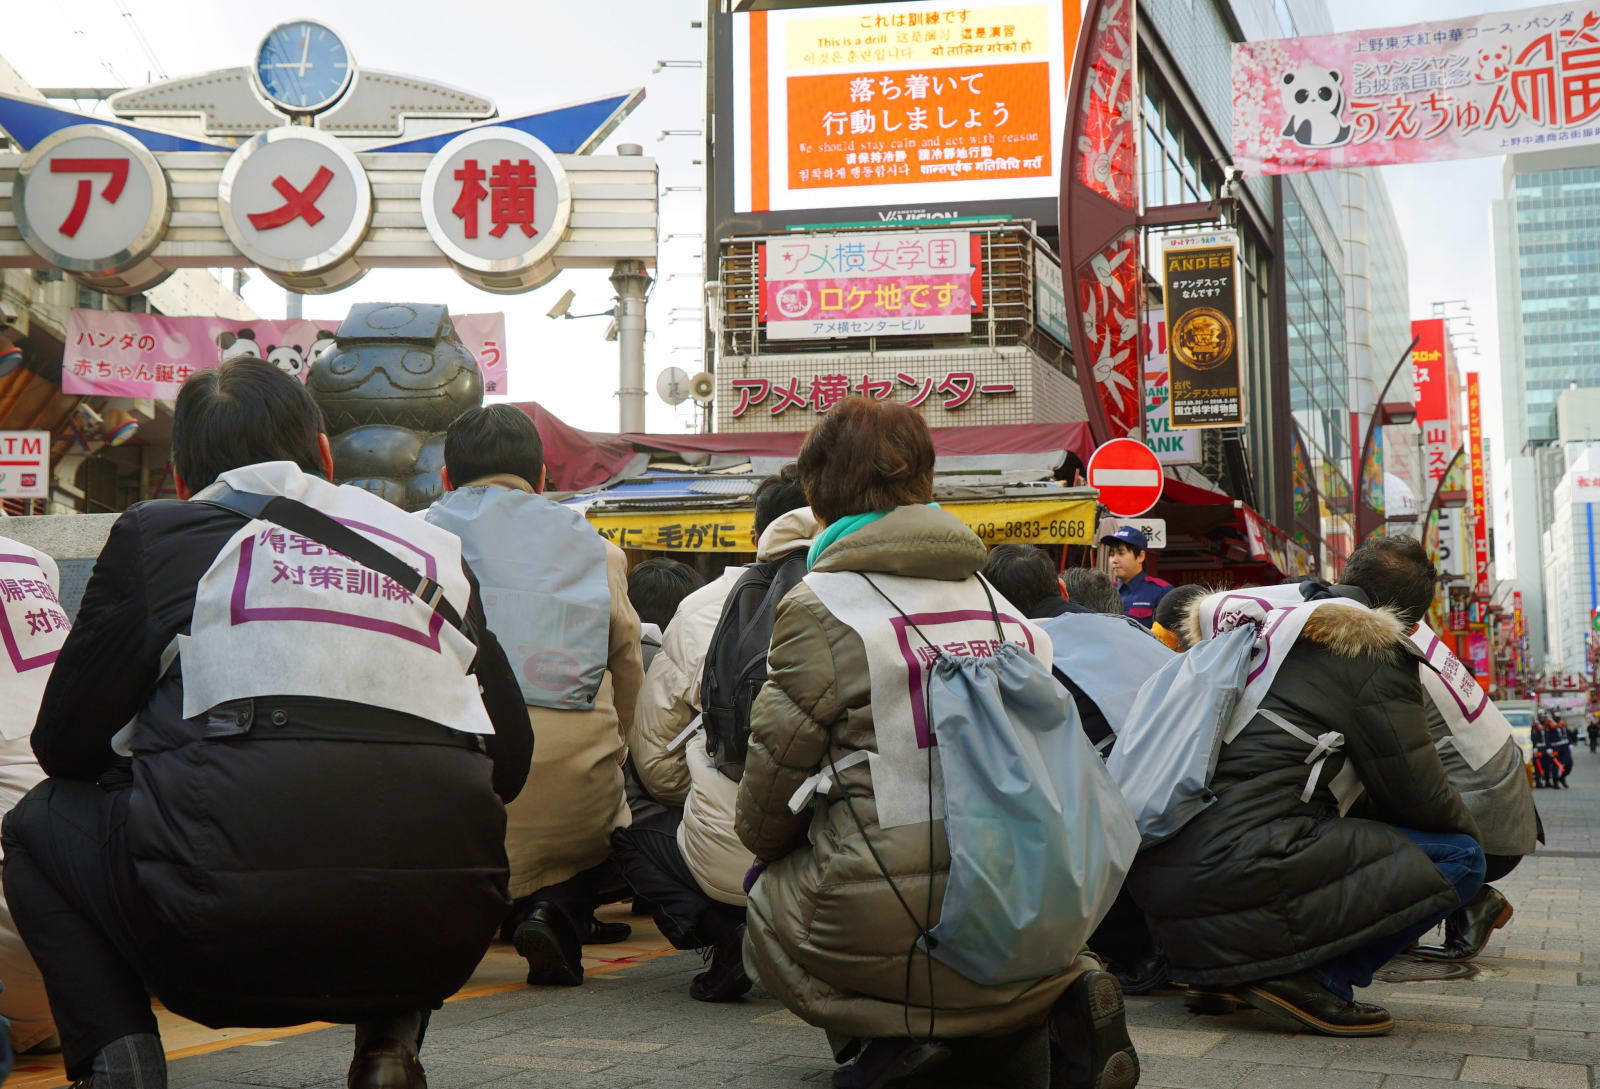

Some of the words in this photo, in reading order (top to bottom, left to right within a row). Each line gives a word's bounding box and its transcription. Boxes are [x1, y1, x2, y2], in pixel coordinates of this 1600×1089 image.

[861, 9, 971, 28] これは訓練です
[818, 37, 840, 48] This
[843, 37, 852, 47] is
[855, 38, 862, 46] a
[865, 34, 887, 45] drill
[1354, 54, 1466, 78] シャンシャン
[850, 73, 984, 103] 落ち着いて
[1354, 69, 1467, 94] お披露目記念
[822, 102, 1009, 136] 行動しましょう
[799, 143, 812, 153] We
[819, 141, 855, 152] should
[861, 140, 884, 152] stay
[891, 137, 916, 149] calm
[921, 136, 940, 147] and
[945, 136, 964, 146] act
[970, 133, 995, 144] with
[1002, 132, 1039, 143] reason
[50, 158, 537, 238] アメ横
[781, 238, 957, 274] アメ横女学園
[1169, 256, 1231, 272] ANDES
[820, 281, 959, 312] ロケ地です
[813, 320, 925, 334] アメ横センタービル
[77, 329, 155, 352] パンダの
[481, 341, 500, 367] う
[73, 359, 194, 383] 赤ちゃん誕生
[732, 372, 1015, 418] アメ横センター
[0, 437, 42, 455] TM
[1147, 436, 1185, 452] ANK
[657, 523, 737, 550] 毛がに
[977, 520, 1085, 540] 03-3833-6668
[271, 559, 414, 605] 対策訓練
